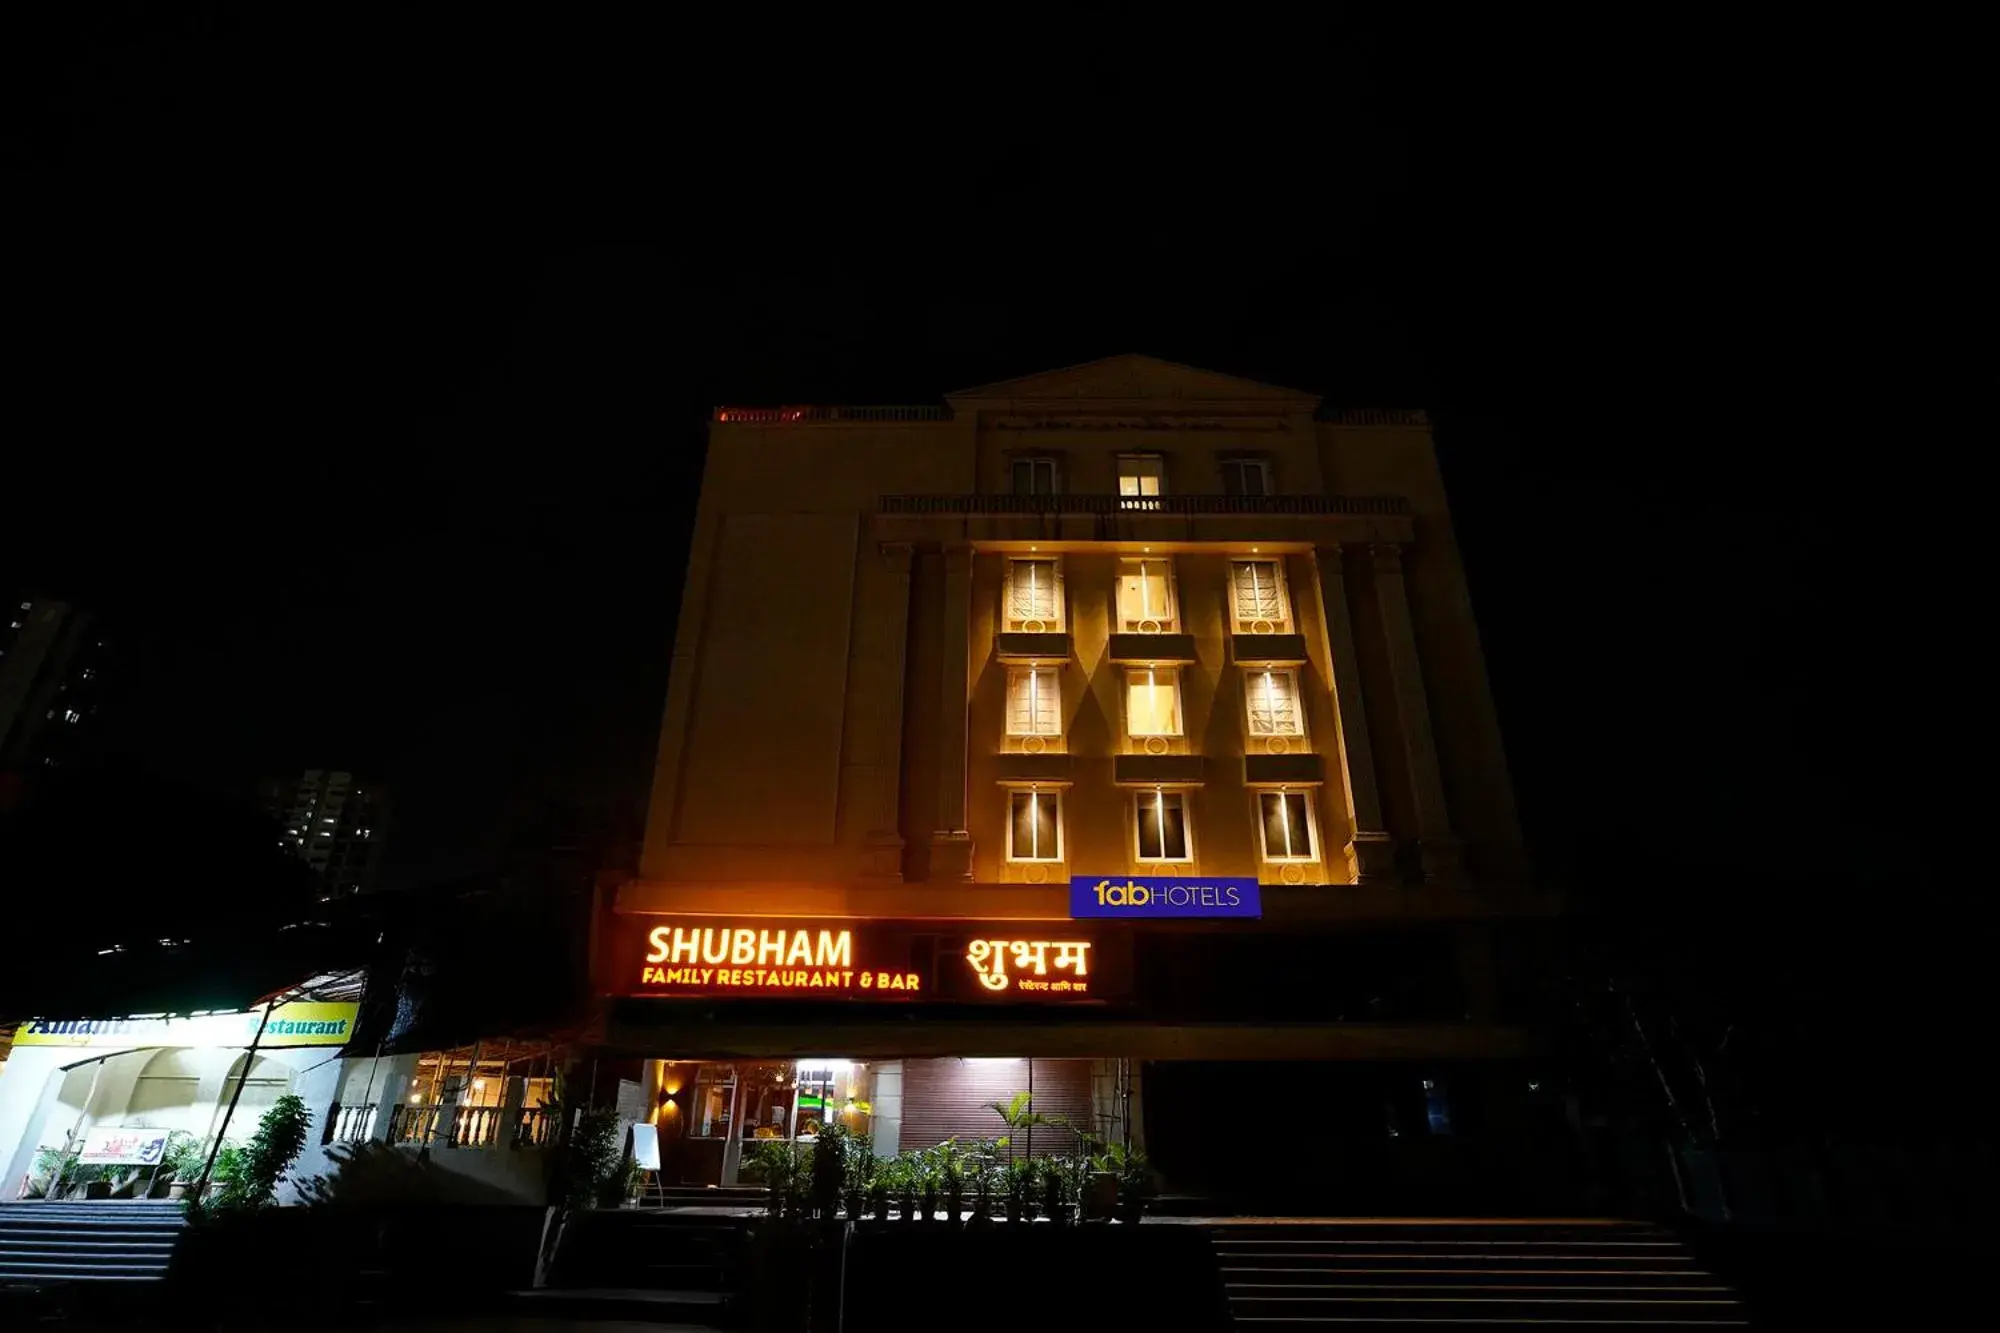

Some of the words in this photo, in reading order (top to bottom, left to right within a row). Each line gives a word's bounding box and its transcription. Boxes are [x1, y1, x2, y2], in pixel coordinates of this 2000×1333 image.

[646, 926, 852, 967] SHUBHAM
[966, 939, 1091, 990] शुभम
[642, 967, 714, 985] FAMILY
[717, 968, 853, 988] RESTAURANT
[859, 974, 872, 988] &
[877, 972, 920, 990] BAR
